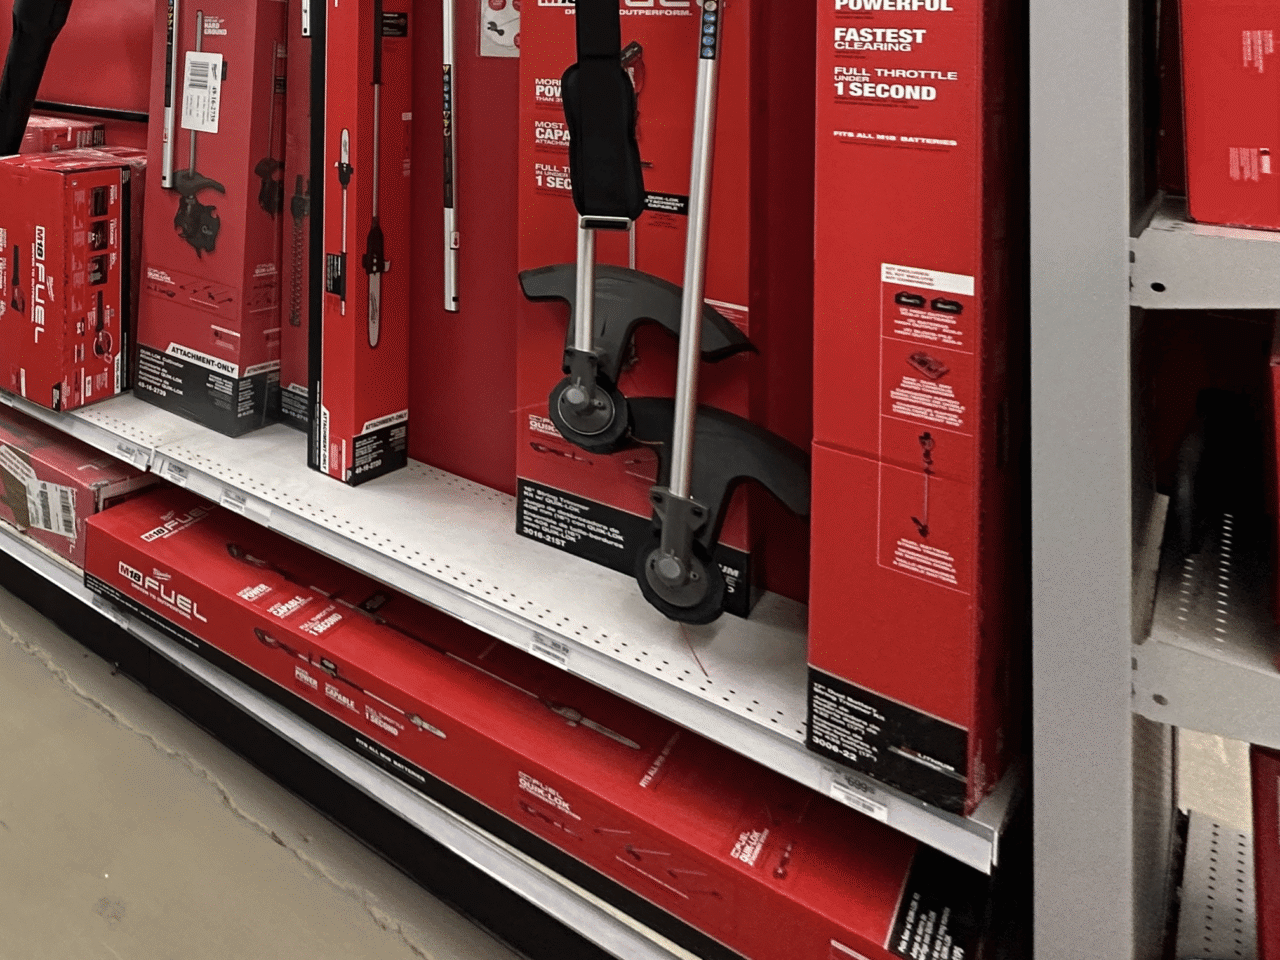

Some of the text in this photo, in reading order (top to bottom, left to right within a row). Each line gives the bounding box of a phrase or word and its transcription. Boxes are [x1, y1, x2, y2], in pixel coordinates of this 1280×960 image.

[834, 27, 926, 44] FASTEST
[834, 41, 912, 52] CLEARING
[834, 66, 958, 81] FULL THROTTLE
[834, 82, 937, 101] 1 SECOND
[535, 121, 564, 129] MOST
[535, 129, 570, 140] CAPA
[833, 130, 855, 138] FITS
[856, 132, 874, 140] ALL
[900, 136, 958, 147] BATTERIES
[535, 163, 560, 173] FULL
[535, 176, 572, 190] 1 SEC
[36, 227, 45, 259] M18
[34, 263, 45, 343] FUEL
[171, 346, 235, 374] ATTACHMENT-ONLY
[523, 526, 567, 547] 3016-21ST
[120, 564, 142, 582] M18
[145, 577, 208, 623] FUEL
[272, 595, 307, 617] CAPABLE
[314, 613, 342, 632] SECOND
[519, 778, 570, 809] QUIK-LOK
[739, 831, 761, 862] QUIK-LOK
